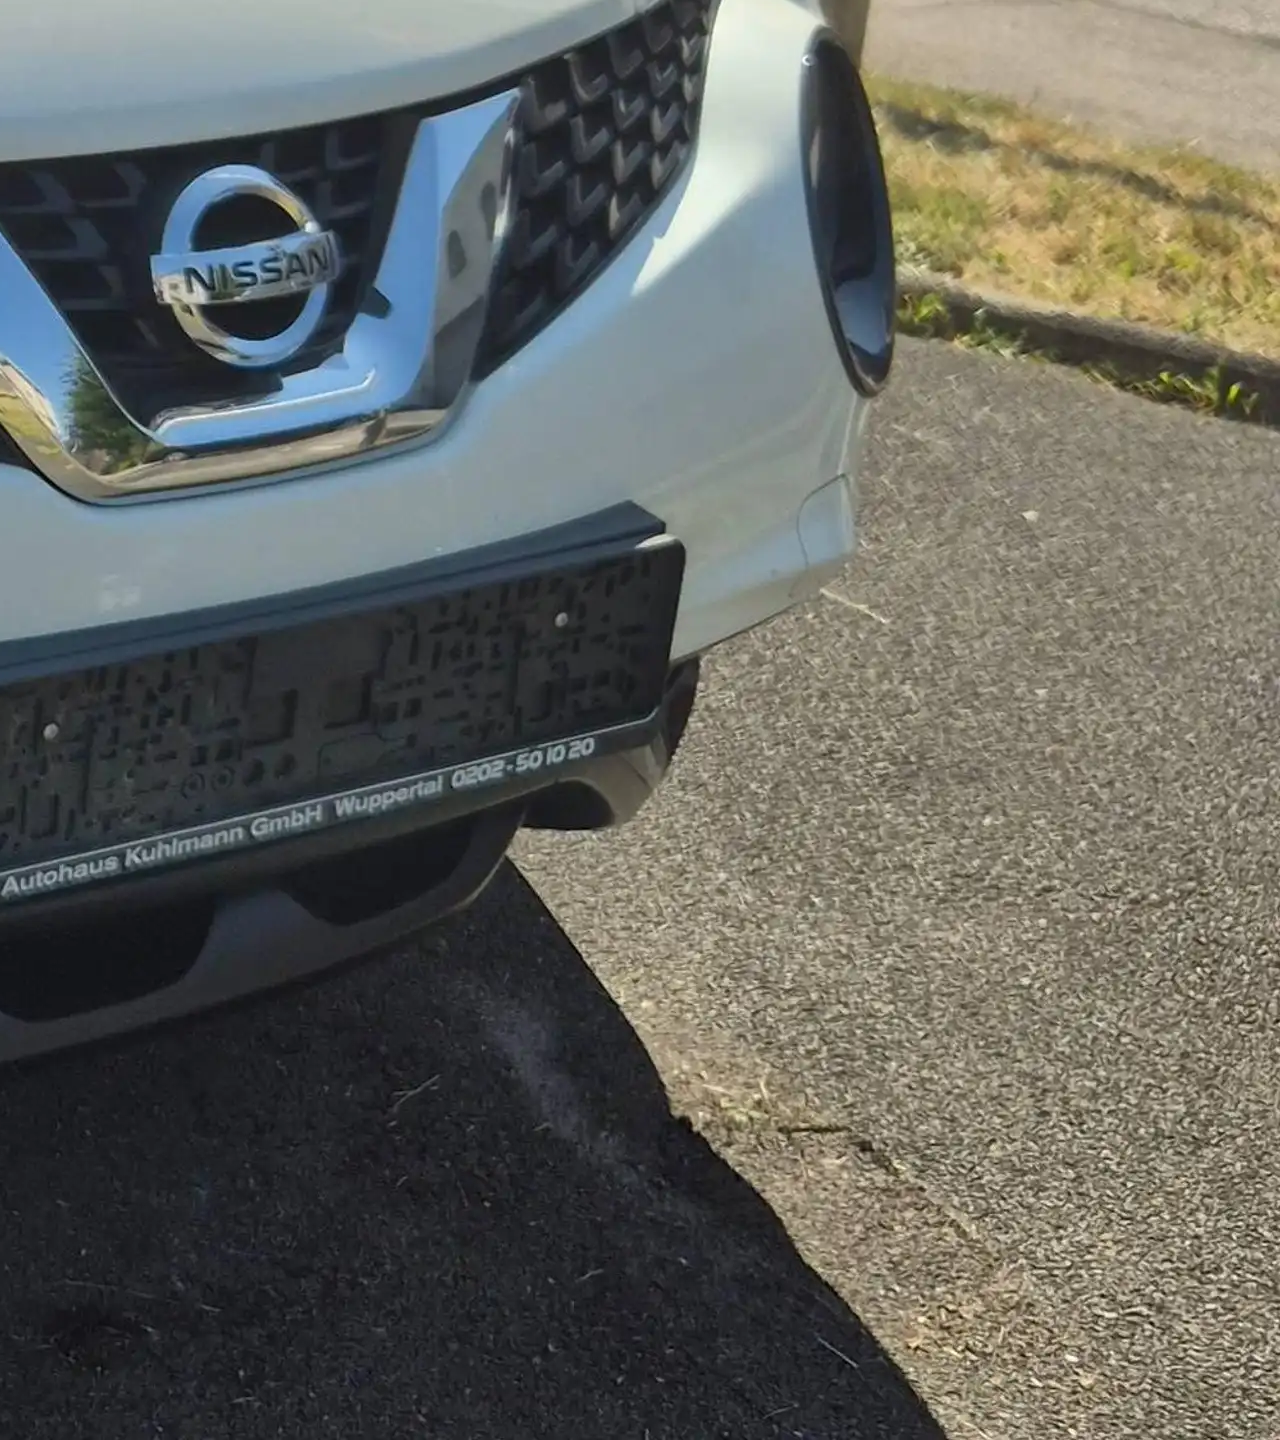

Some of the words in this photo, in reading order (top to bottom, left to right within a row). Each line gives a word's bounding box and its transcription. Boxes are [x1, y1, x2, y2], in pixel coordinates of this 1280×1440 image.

[183, 234, 332, 293] NISSAN
[0, 855, 119, 898] Autohaus
[124, 826, 244, 868] Kuhlmann
[250, 803, 324, 839] GmbH
[334, 775, 443, 816] Wuppertal
